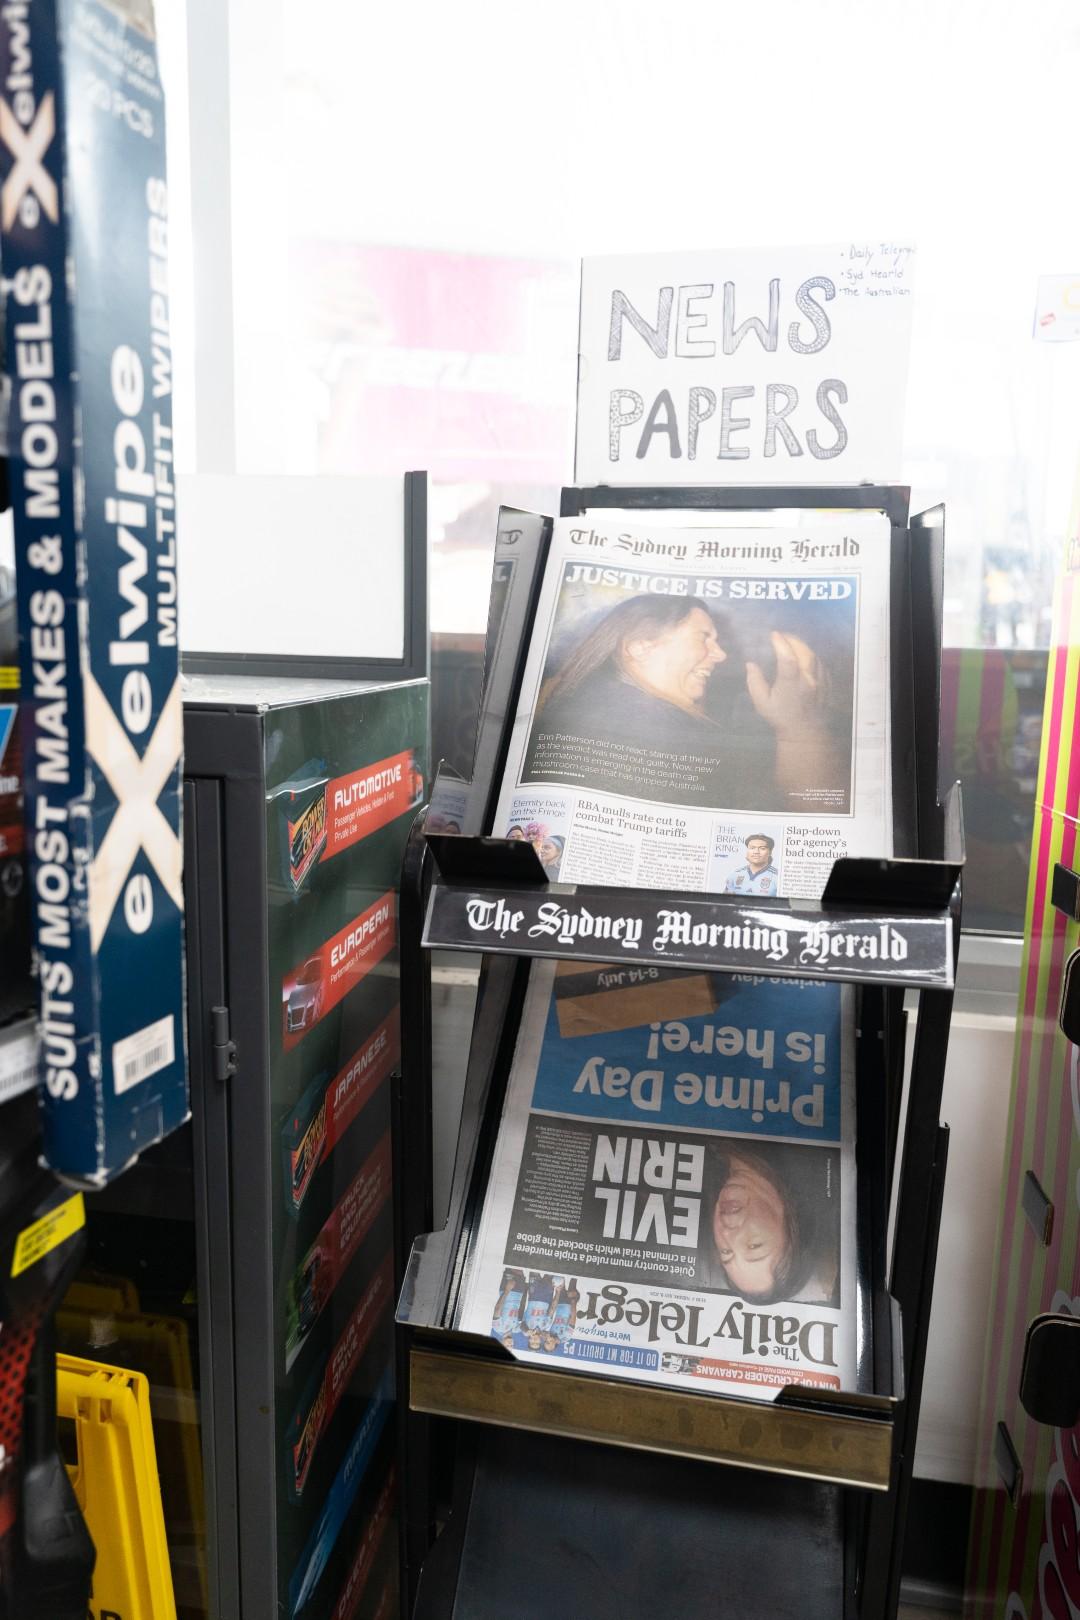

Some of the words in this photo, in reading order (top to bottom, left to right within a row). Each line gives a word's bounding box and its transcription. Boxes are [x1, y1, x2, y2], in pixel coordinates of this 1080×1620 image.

[849, 243, 875, 266] Daily
[146, 177, 172, 398] WIPERS
[607, 276, 836, 361] NEWS
[14, 264, 61, 518] MODELS
[608, 378, 849, 462] PAPERS
[153, 412, 177, 646] MULTIFIT
[569, 529, 608, 547] The
[613, 533, 688, 561] Sydney
[695, 541, 783, 562] Morning
[789, 536, 860, 563] Herald
[27, 535, 64, 575] &
[566, 565, 690, 597] JUSTICE
[693, 578, 723, 599] IS
[729, 580, 853, 601] SERVED
[30, 589, 70, 784] MAKES
[555, 733, 595, 745] Patterson
[534, 751, 582, 762] information
[642, 767, 656, 775] the
[694, 766, 713, 774] new
[334, 764, 402, 812] AUTOMOTIVE
[523, 807, 537, 815] the
[577, 800, 600, 812] RBA
[602, 806, 631, 819] mulls
[633, 813, 654, 823] rate
[656, 816, 673, 826] cut
[675, 818, 686, 828] to
[575, 811, 615, 826] combat
[617, 818, 653, 834] Trump
[655, 826, 688, 839] tariffs
[718, 825, 737, 835] THE
[786, 826, 841, 838] Slap-down
[716, 834, 746, 844] BRIAN
[785, 836, 801, 846] for
[803, 838, 848, 849] agency's
[715, 844, 739, 853] KING
[785, 848, 804, 858] bad
[806, 850, 849, 859] conduct
[35, 796, 72, 948] MOST
[331, 904, 389, 967] EUROPEAN
[466, 898, 525, 938] The
[527, 901, 643, 949] Sydney
[653, 908, 790, 960] Morning
[799, 920, 909, 964] Herald
[597, 972, 626, 988] July
[629, 967, 659, 983] 8-14
[41, 961, 79, 1100] SUITS
[646, 1021, 775, 1070] here!
[785, 1030, 826, 1075] is
[333, 1029, 388, 1108] JAPANESE
[573, 1056, 665, 1112] Day
[673, 1070, 825, 1128] Prime
[591, 1133, 706, 1192] ERIN
[595, 1186, 702, 1248] EVIL
[516, 1232, 541, 1245] globe
[542, 1238, 557, 1247] the
[558, 1239, 594, 1252] shocked
[513, 1243, 553, 1257] murderer
[555, 1250, 578, 1262] triple
[595, 1244, 621, 1256] which
[622, 1248, 641, 1258] trial
[642, 1250, 679, 1262] criminal
[586, 1254, 609, 1265] ruled
[610, 1258, 633, 1268] mum
[634, 1260, 669, 1273] country
[687, 1256, 696, 1266] in
[670, 1265, 696, 1277] Quiet
[576, 1284, 711, 1348] Telegr
[609, 1331, 631, 1342] We're
[713, 1301, 838, 1367] Daily
[577, 1343, 605, 1360] DRUITT
[607, 1348, 618, 1361] MT
[620, 1350, 634, 1363] FOR
[636, 1352, 644, 1365] IT
[773, 1346, 799, 1361] The
[646, 1353, 657, 1367] DO
[696, 1365, 743, 1378] CARAVANS
[744, 1371, 792, 1385] CRUSADER
